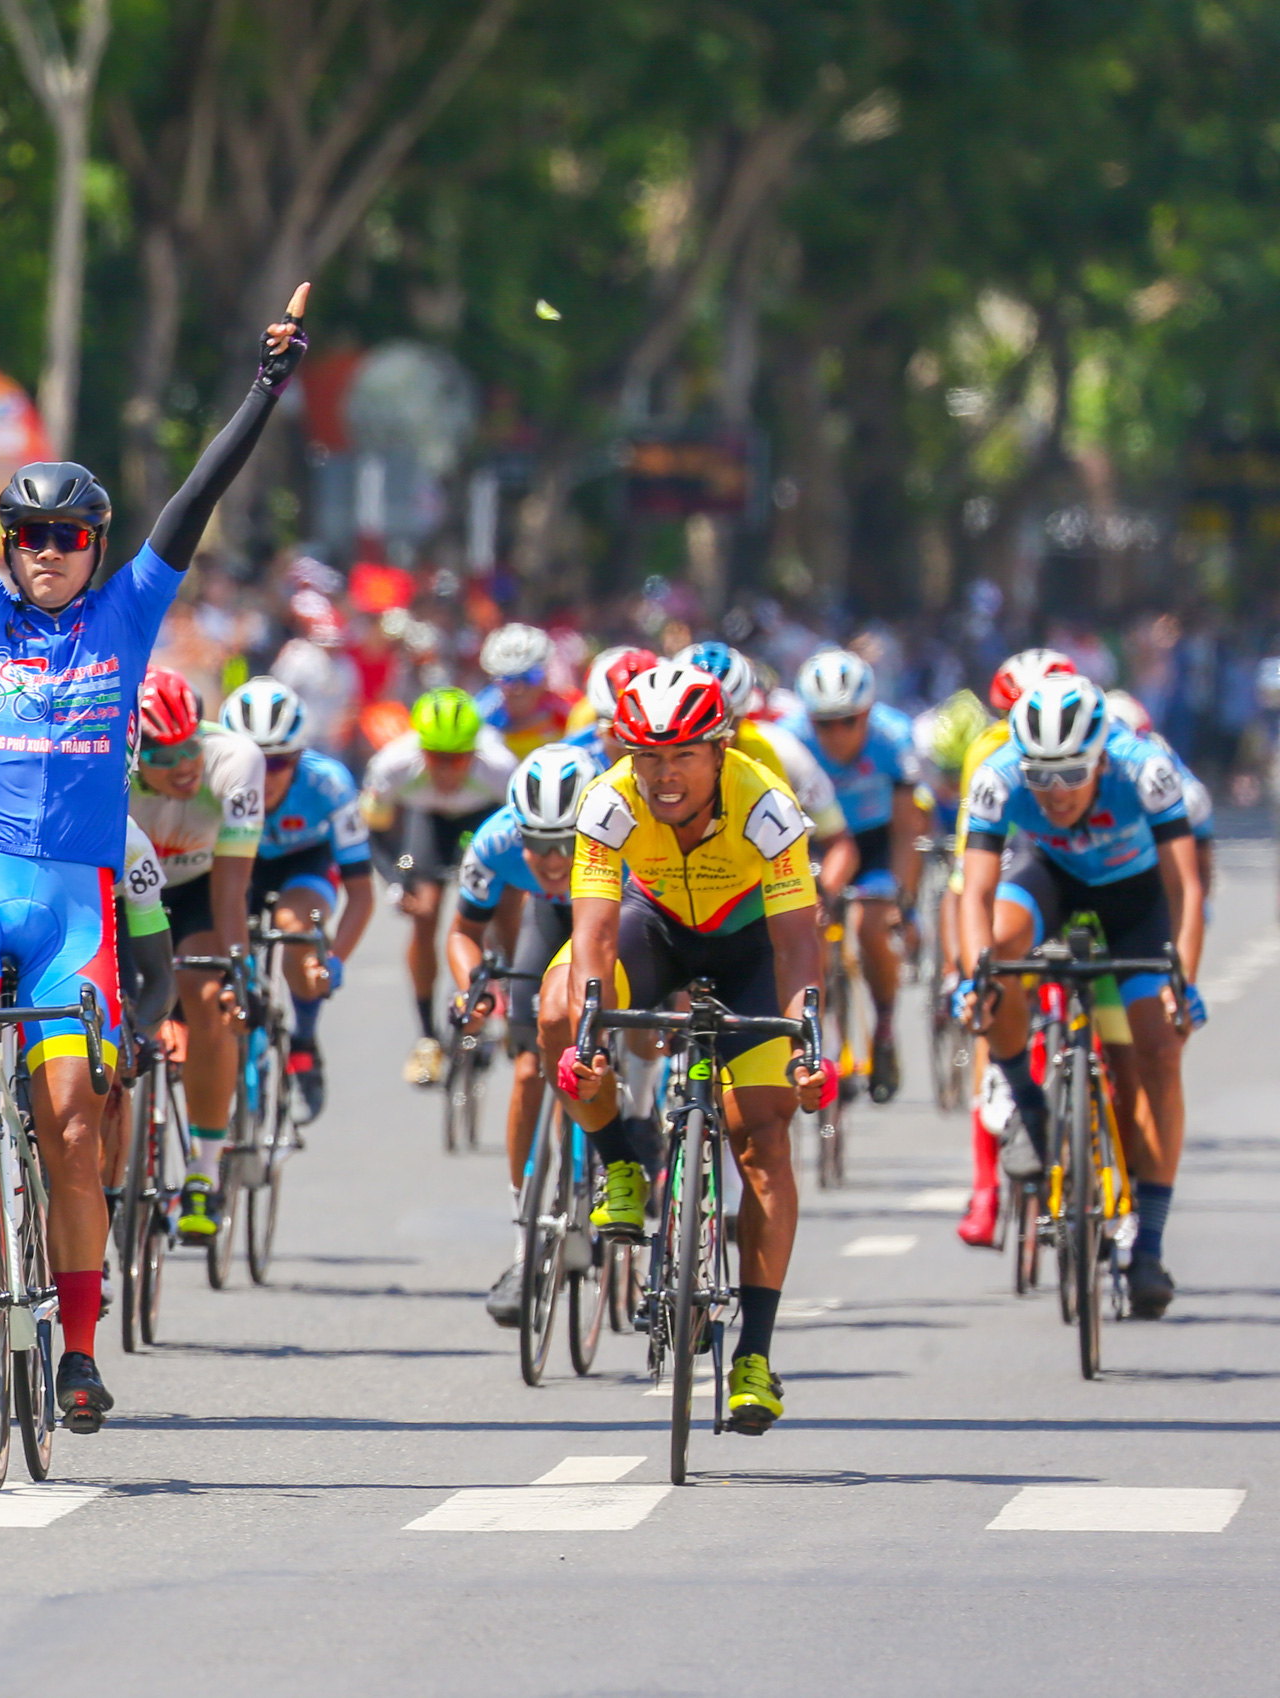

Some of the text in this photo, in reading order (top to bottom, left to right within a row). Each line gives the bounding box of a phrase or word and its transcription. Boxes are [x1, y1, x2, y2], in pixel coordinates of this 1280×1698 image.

[6, 734, 26, 752] PHÚ
[60, 736, 91, 754] TRÀNG
[231, 789, 260, 819] 82
[596, 802, 620, 831] 1
[761, 810, 789, 836] 1
[128, 859, 160, 896] 83
